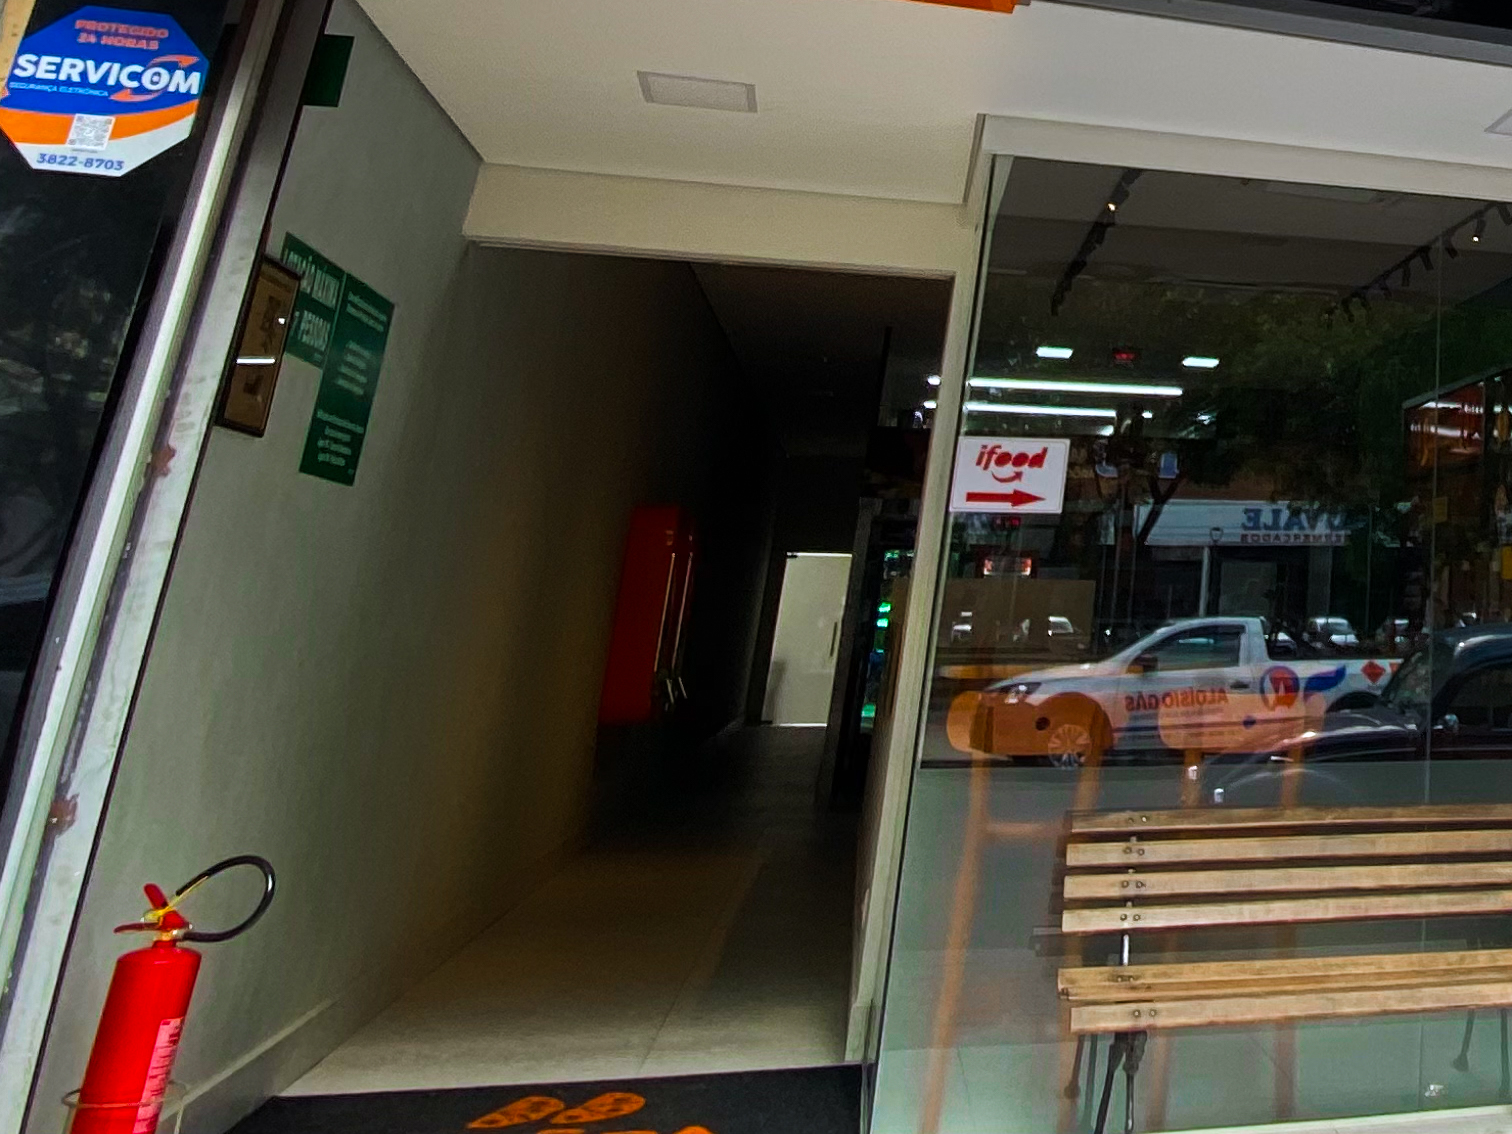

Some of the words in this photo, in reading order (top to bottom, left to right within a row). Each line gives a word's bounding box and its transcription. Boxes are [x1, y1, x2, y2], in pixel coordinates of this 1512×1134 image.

[75, 19, 169, 39] PROTEGIDO
[101, 34, 159, 51] HORAS
[12, 53, 202, 95] SERVICOM
[36, 152, 125, 171] 3822-8703
[975, 444, 1049, 472] ifood
